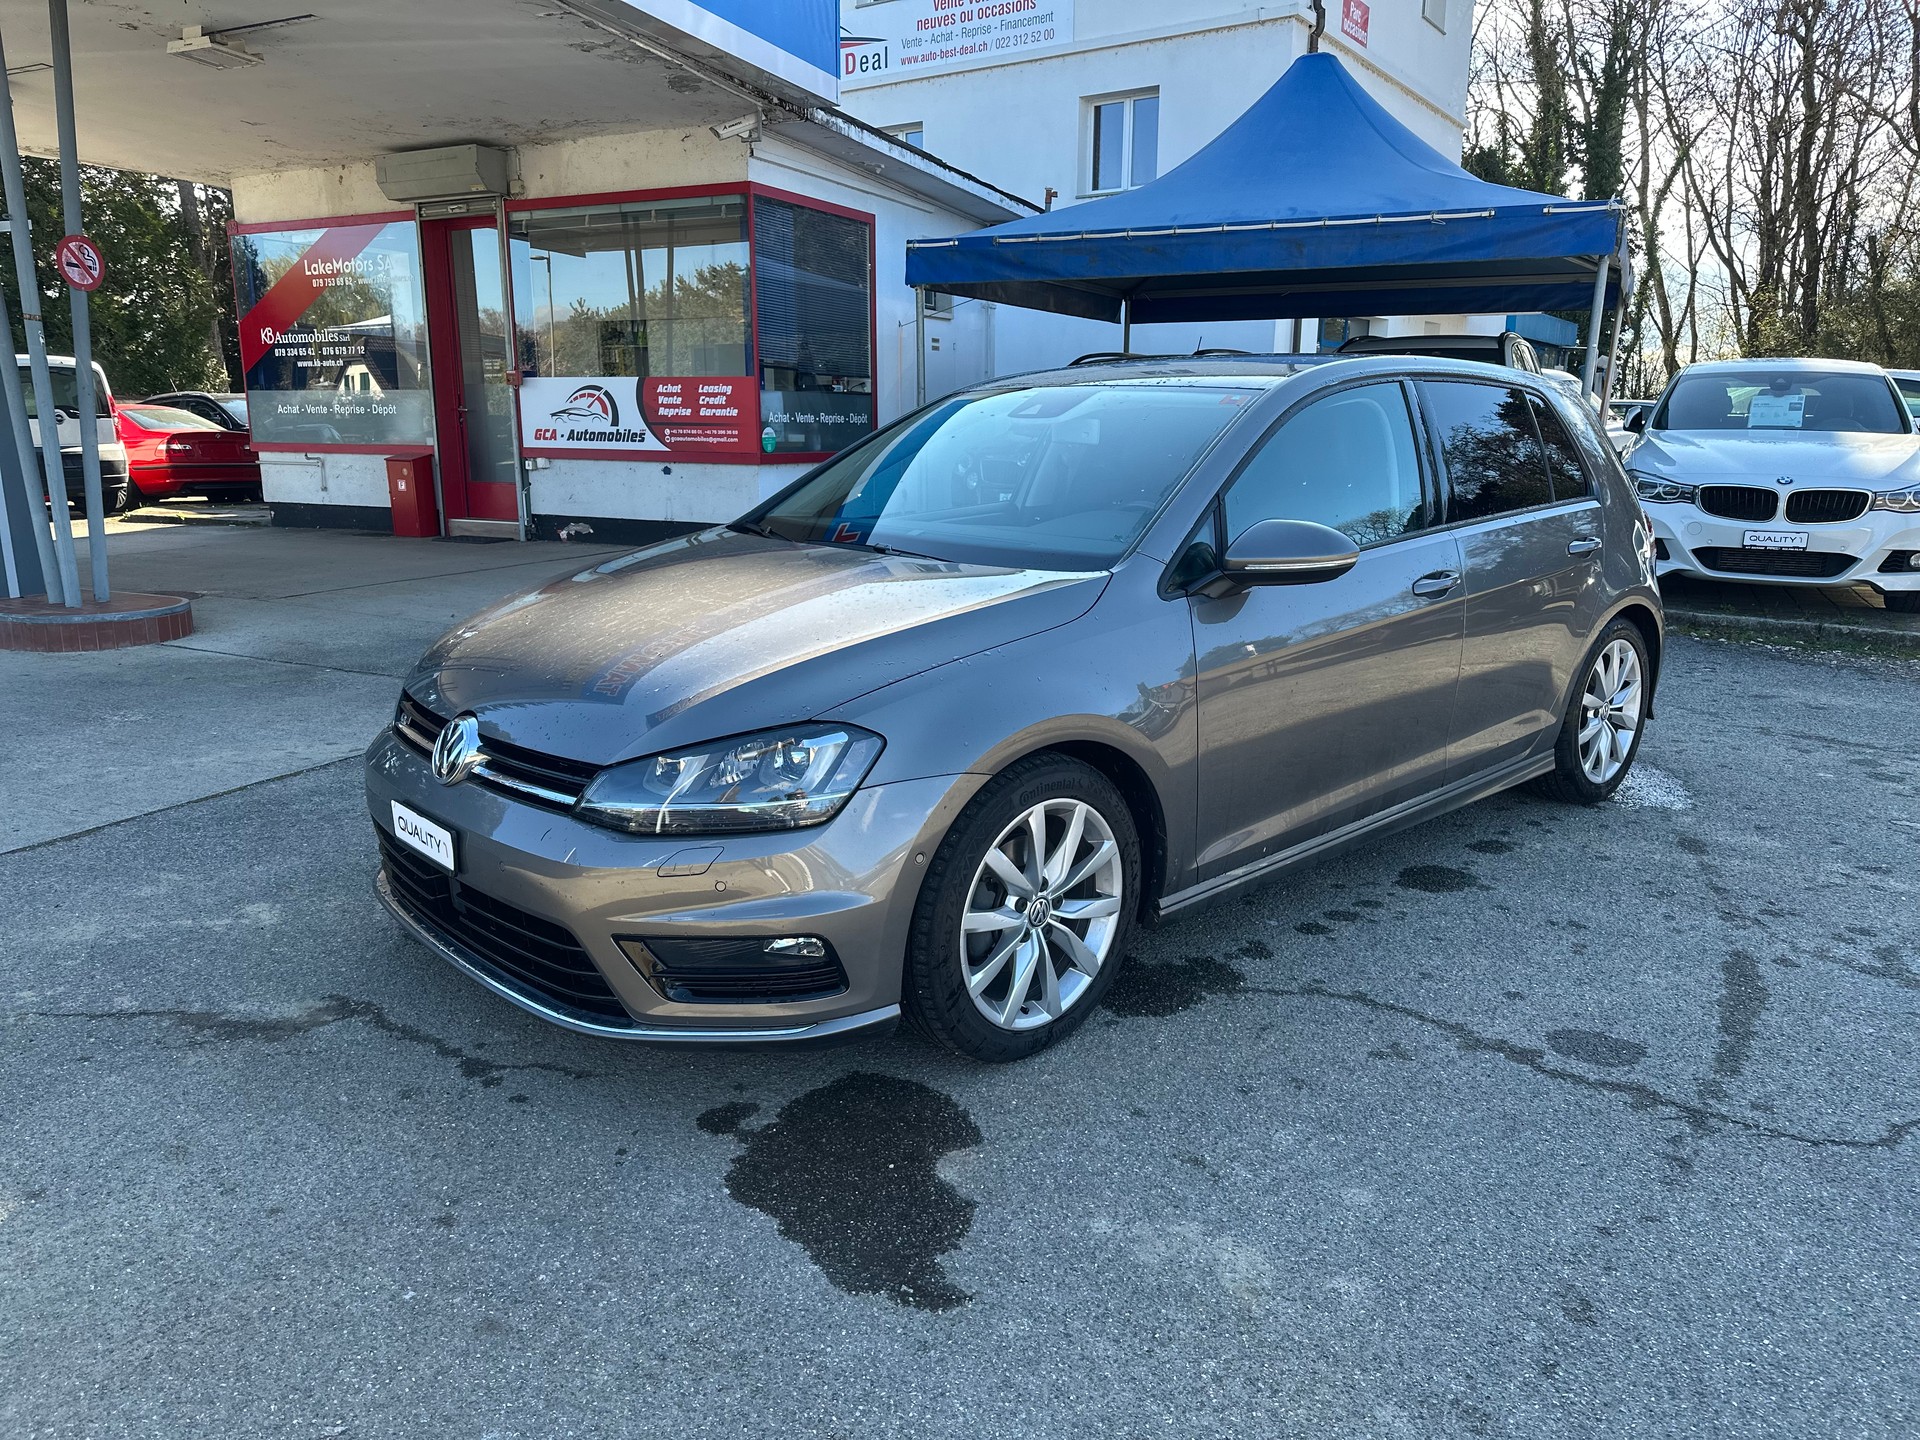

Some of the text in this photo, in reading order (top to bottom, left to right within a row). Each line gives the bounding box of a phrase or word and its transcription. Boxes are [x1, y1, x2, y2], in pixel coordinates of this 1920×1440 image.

[916, 0, 1037, 31] neuves ou occasions
[901, 37, 923, 49] Vente
[930, 30, 954, 44] Achat
[961, 24, 992, 39] Reprise
[1000, 11, 1054, 31] Financement
[900, 40, 988, 65] www.auto-best-deal.ch
[995, 36, 1011, 49] 022
[1013, 33, 1028, 46] 312
[1031, 30, 1041, 43] 52
[1043, 28, 1055, 41] 00
[845, 46, 888, 75] Deal
[304, 254, 394, 275] LakeMotors SA
[312, 278, 324, 287] 079
[324, 277, 336, 286] 753
[274, 348, 286, 357] 079
[287, 348, 298, 357] 334
[299, 347, 307, 356] 65
[307, 347, 316, 356] 41
[322, 347, 334, 355] 076
[335, 346, 347, 355] 679
[347, 346, 355, 355] 77
[356, 346, 365, 355] 12
[297, 359, 344, 368] www.kb-auto.ch
[656, 383, 682, 393] Achat
[698, 384, 732, 395] Leasing
[658, 395, 682, 404] Vente
[698, 395, 727, 405] Credit
[277, 404, 300, 414] Achat
[305, 404, 328, 414] Vente
[334, 403, 365, 416] Reprise
[372, 403, 397, 416] Dépôt
[658, 406, 692, 417] Reprise
[699, 407, 739, 417] Garantie
[768, 411, 790, 423] Achat
[795, 412, 815, 423] Vente
[820, 412, 844, 425] Reprise
[849, 413, 868, 425] Dépôt
[534, 428, 557, 441] GCA
[566, 429, 646, 442] Automobiles
[1749, 535, 1797, 543] QUALITY
[1019, 777, 1075, 806] Continental
[398, 816, 441, 853] QUALITY
